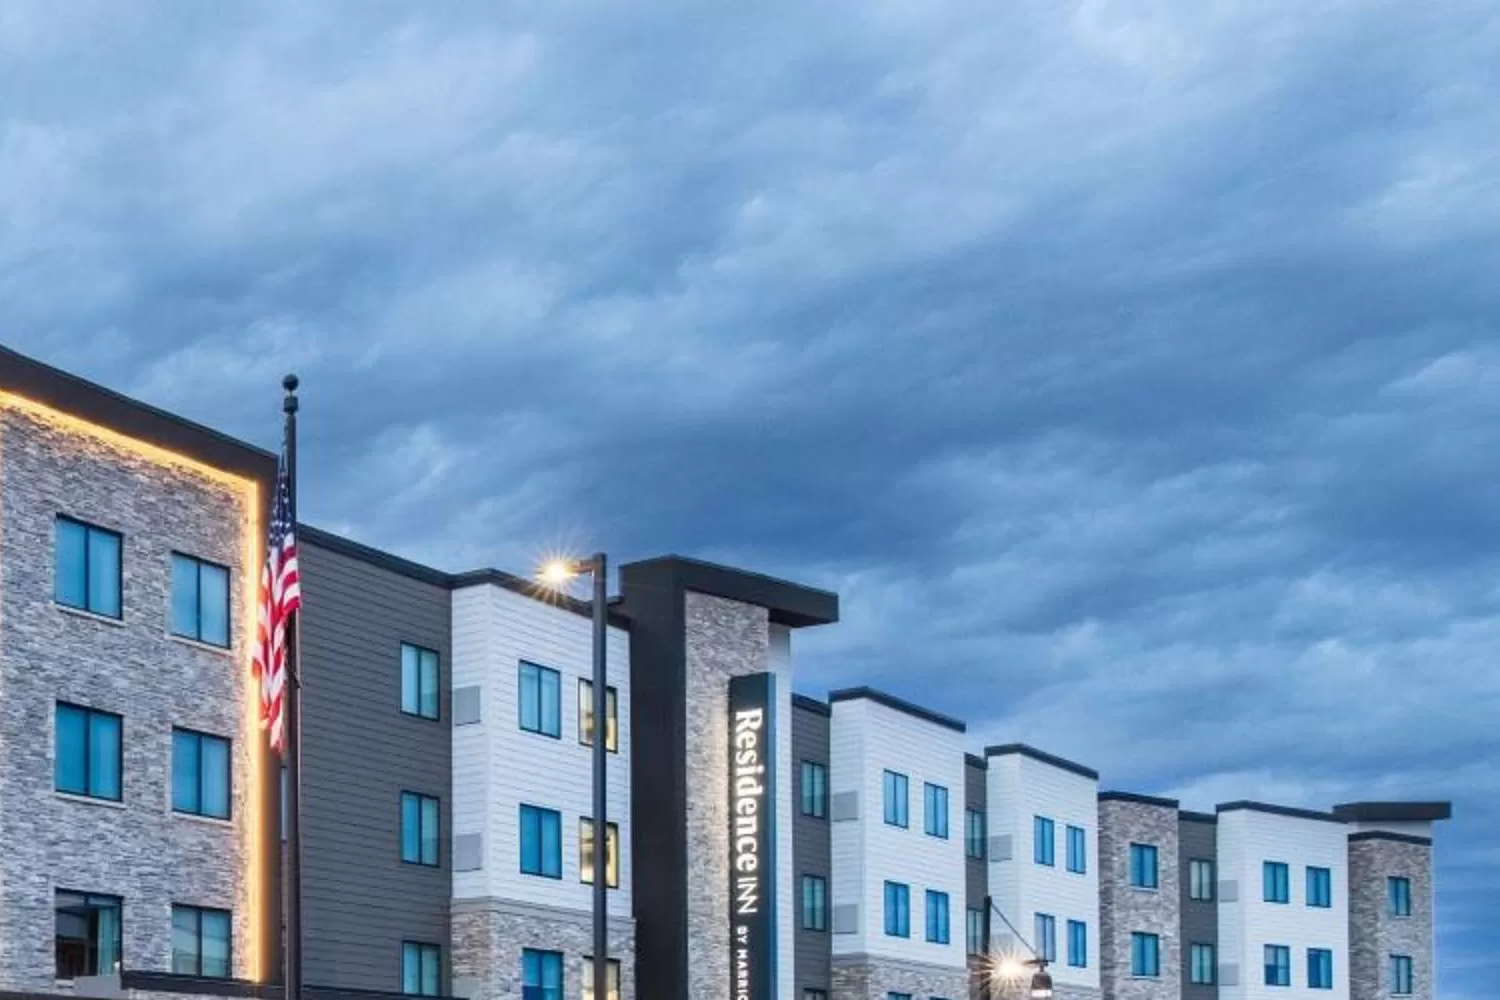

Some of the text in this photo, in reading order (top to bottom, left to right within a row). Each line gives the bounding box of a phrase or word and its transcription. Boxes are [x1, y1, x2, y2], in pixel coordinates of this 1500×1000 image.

[735, 708, 764, 872] Residence
[737, 877, 758, 914] INN
[737, 926, 748, 945] BY
